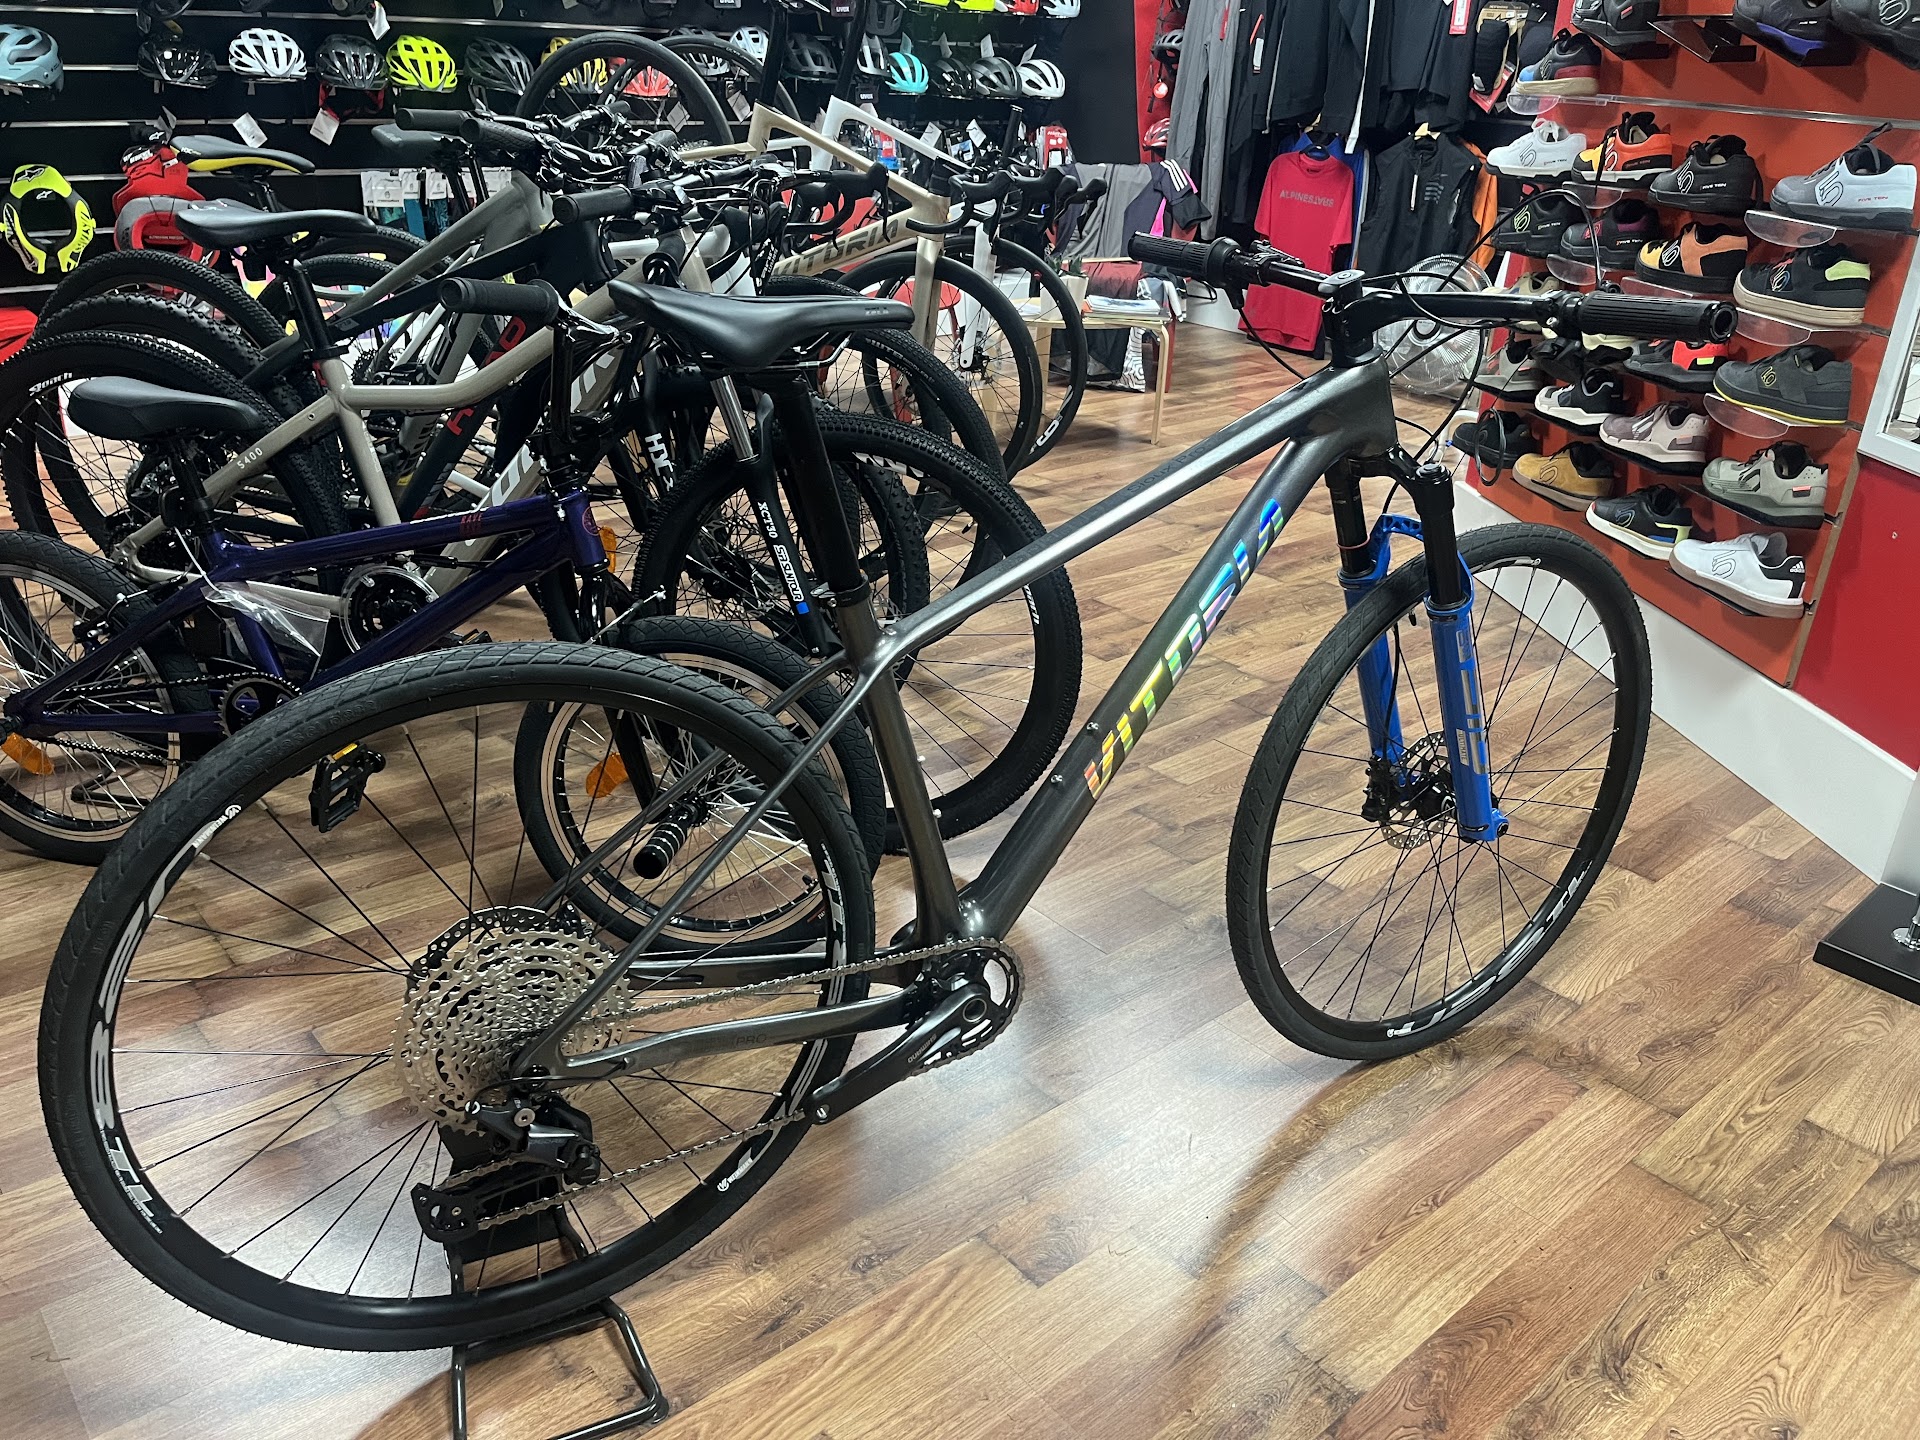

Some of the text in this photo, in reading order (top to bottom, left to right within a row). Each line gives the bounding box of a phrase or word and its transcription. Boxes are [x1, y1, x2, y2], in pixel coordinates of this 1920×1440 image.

[236, 447, 263, 470] 5400
[1175, 446, 1206, 464] Pro
[757, 501, 779, 539] XCT30
[1083, 497, 1285, 801] VITORIA
[191, 813, 230, 850] WEINMANN
[906, 1032, 937, 1065] SHIMANO
